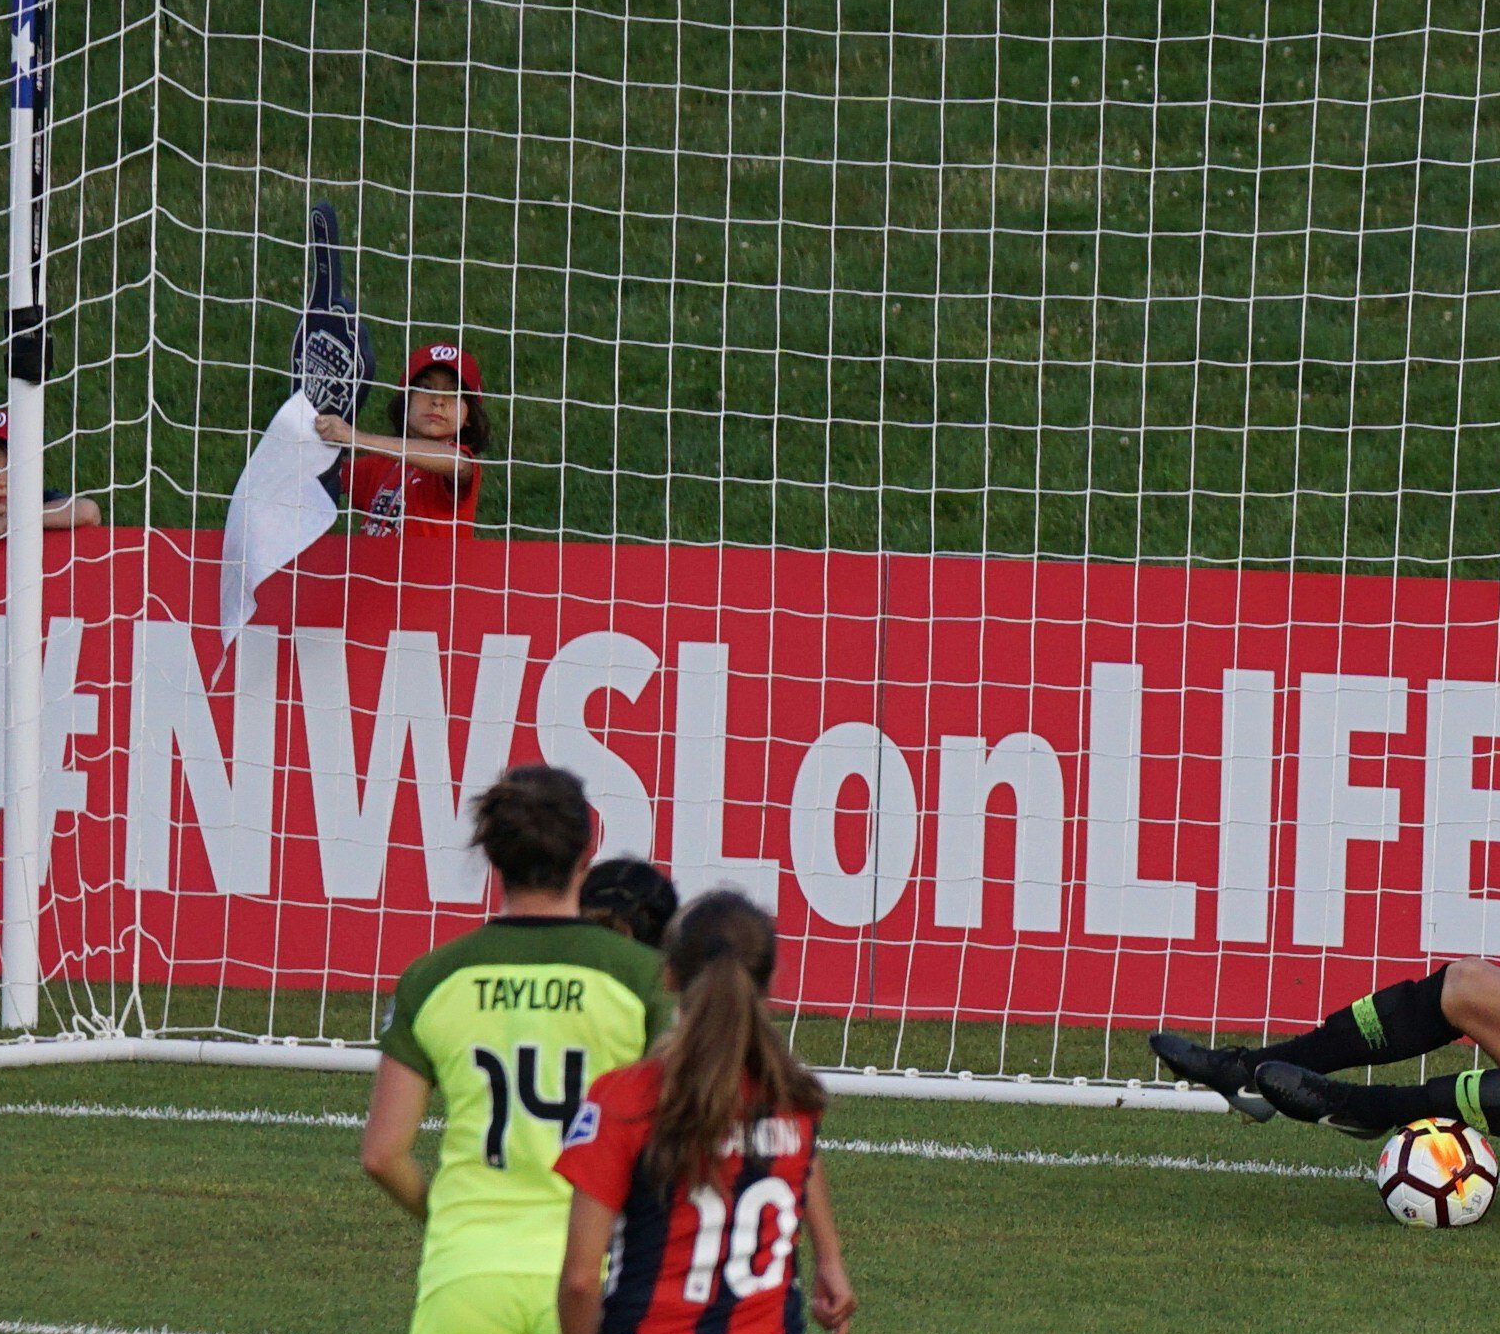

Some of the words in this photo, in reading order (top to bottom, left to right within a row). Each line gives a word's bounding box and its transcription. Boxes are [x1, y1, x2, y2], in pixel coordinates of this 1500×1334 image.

[474, 978, 585, 1012] TAYLOR
[473, 1044, 587, 1169] 14
[683, 1177, 798, 1303] 10
